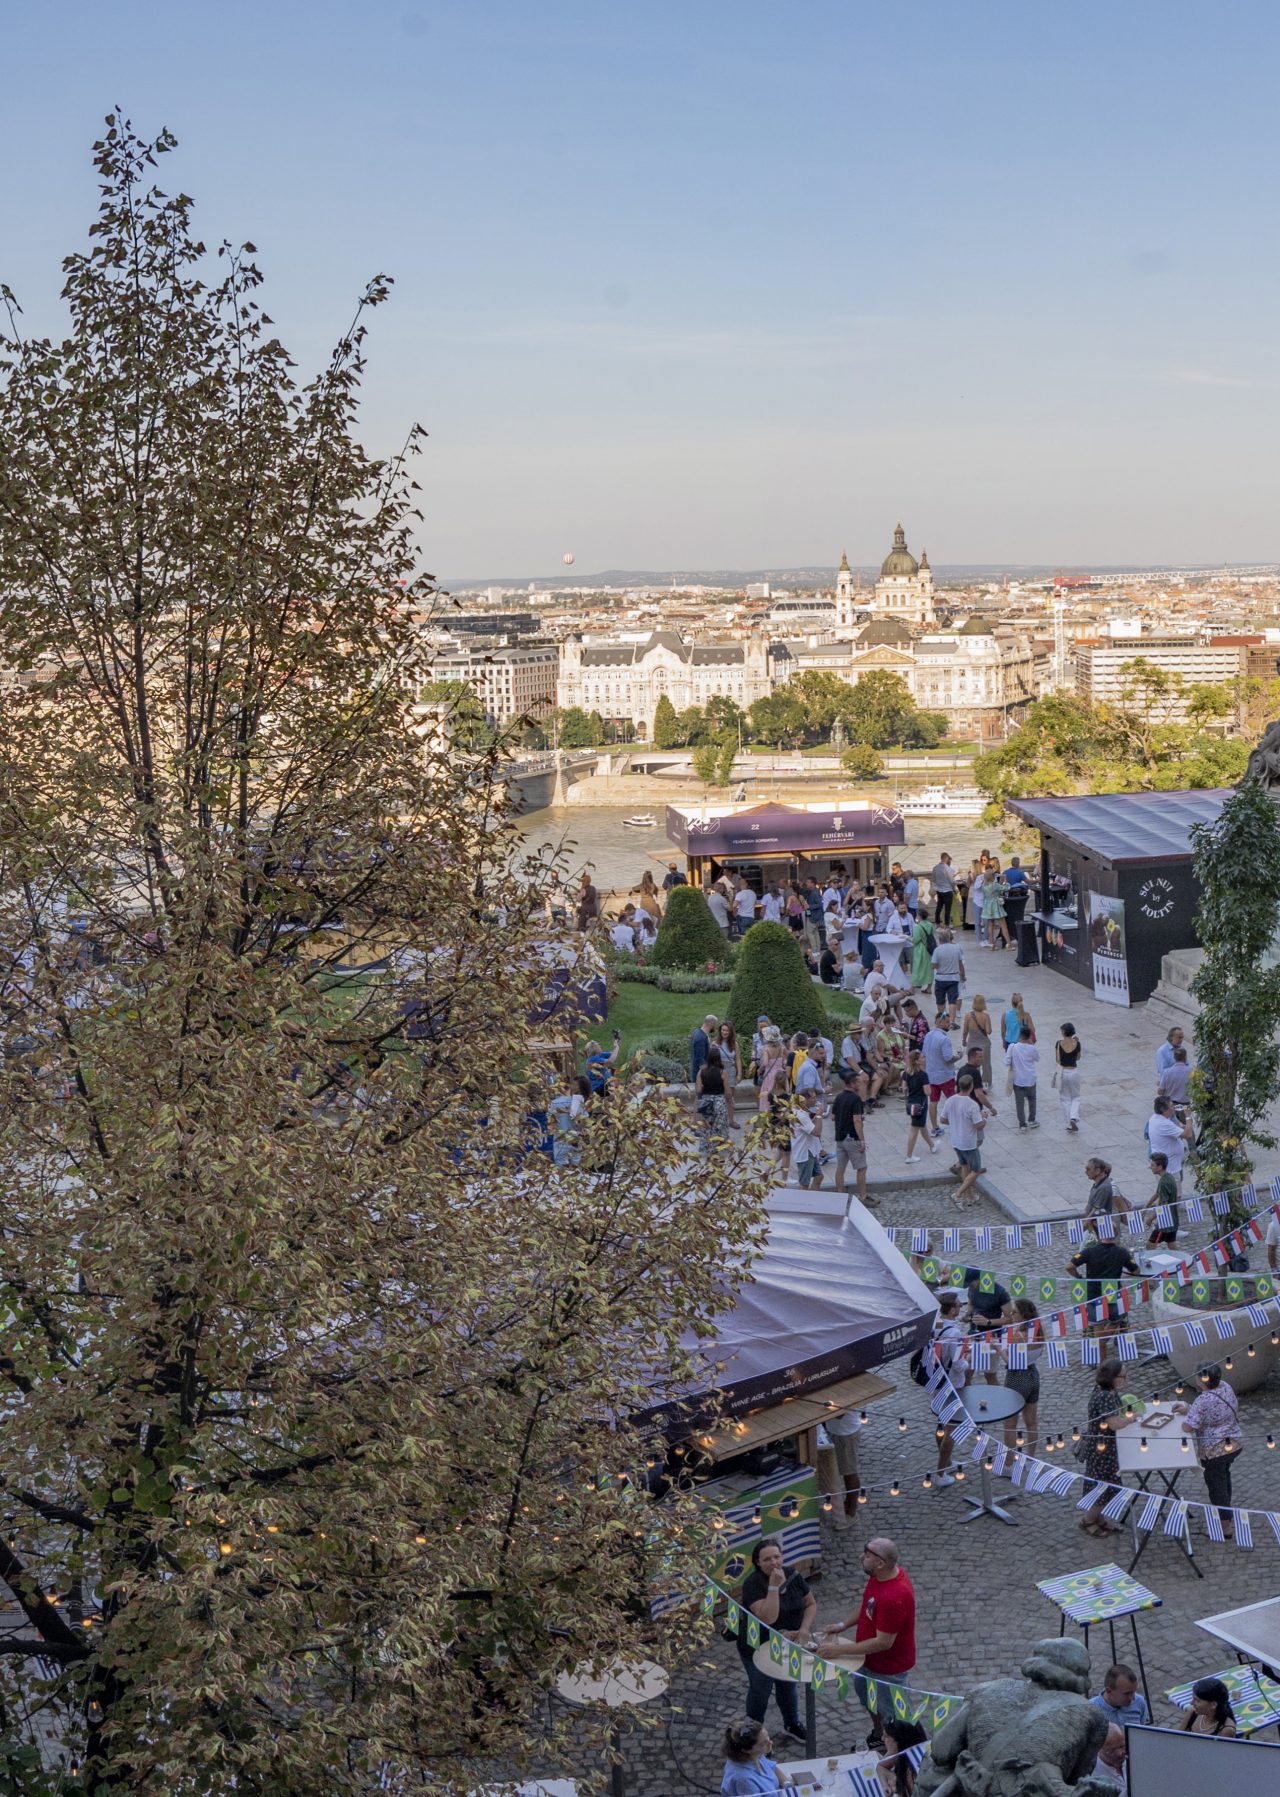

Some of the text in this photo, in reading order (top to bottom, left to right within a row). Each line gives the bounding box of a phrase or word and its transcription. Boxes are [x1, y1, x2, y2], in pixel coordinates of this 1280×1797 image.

[1139, 878, 1174, 897] SUI NUI
[1152, 893, 1161, 902] by
[1140, 899, 1175, 919] FOLTIN
[784, 1367, 796, 1378] 36
[731, 1396, 751, 1409] WINE
[751, 1391, 766, 1402] AGE
[808, 1365, 840, 1383] URUGUAY
